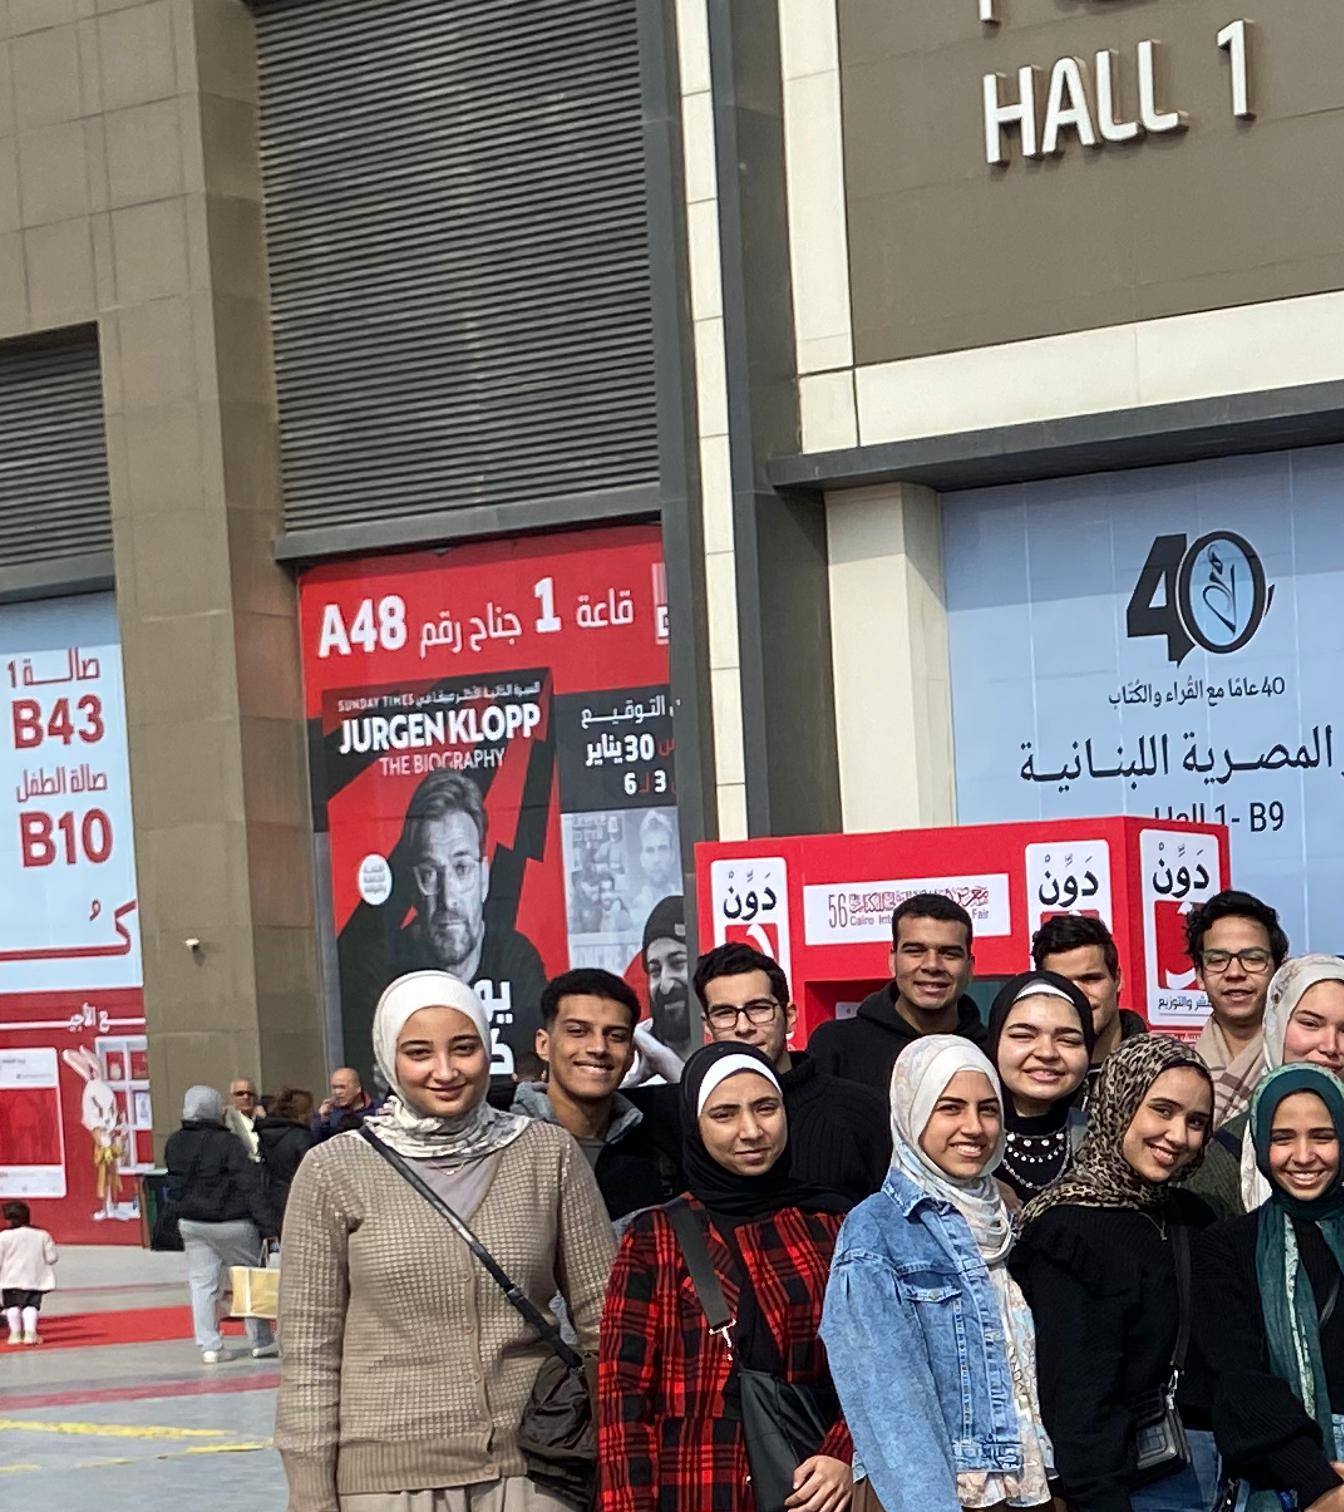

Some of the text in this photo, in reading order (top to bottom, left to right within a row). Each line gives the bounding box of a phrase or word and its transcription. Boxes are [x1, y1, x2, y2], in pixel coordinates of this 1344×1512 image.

[983, 19, 1250, 165] HALL 1
[533, 576, 563, 635] 1
[576, 587, 636, 630] قاعة
[317, 595, 408, 658] A48
[419, 610, 463, 659] رقم
[468, 601, 523, 653] جناح
[7, 660, 18, 689] 1
[338, 697, 380, 713] SUNDAY
[382, 693, 415, 708] TIMES
[1205, 685, 1225, 707] مع
[11, 693, 106, 750] B43
[339, 703, 542, 755] JURGEN KLOPP
[379, 747, 506, 777] THE BIOGRAPHY
[585, 733, 656, 767] 30 يناير
[1020, 733, 1169, 793] اللبنانية
[1182, 724, 1333, 785] المصرية
[16, 763, 109, 803] صالة الطفل
[623, 772, 638, 795] 6
[654, 769, 667, 793] 3
[1250, 801, 1285, 833] B9
[18, 807, 115, 869] B10
[828, 892, 849, 929] 56
[850, 914, 875, 927] Cairo
[971, 908, 990, 920] Fair
